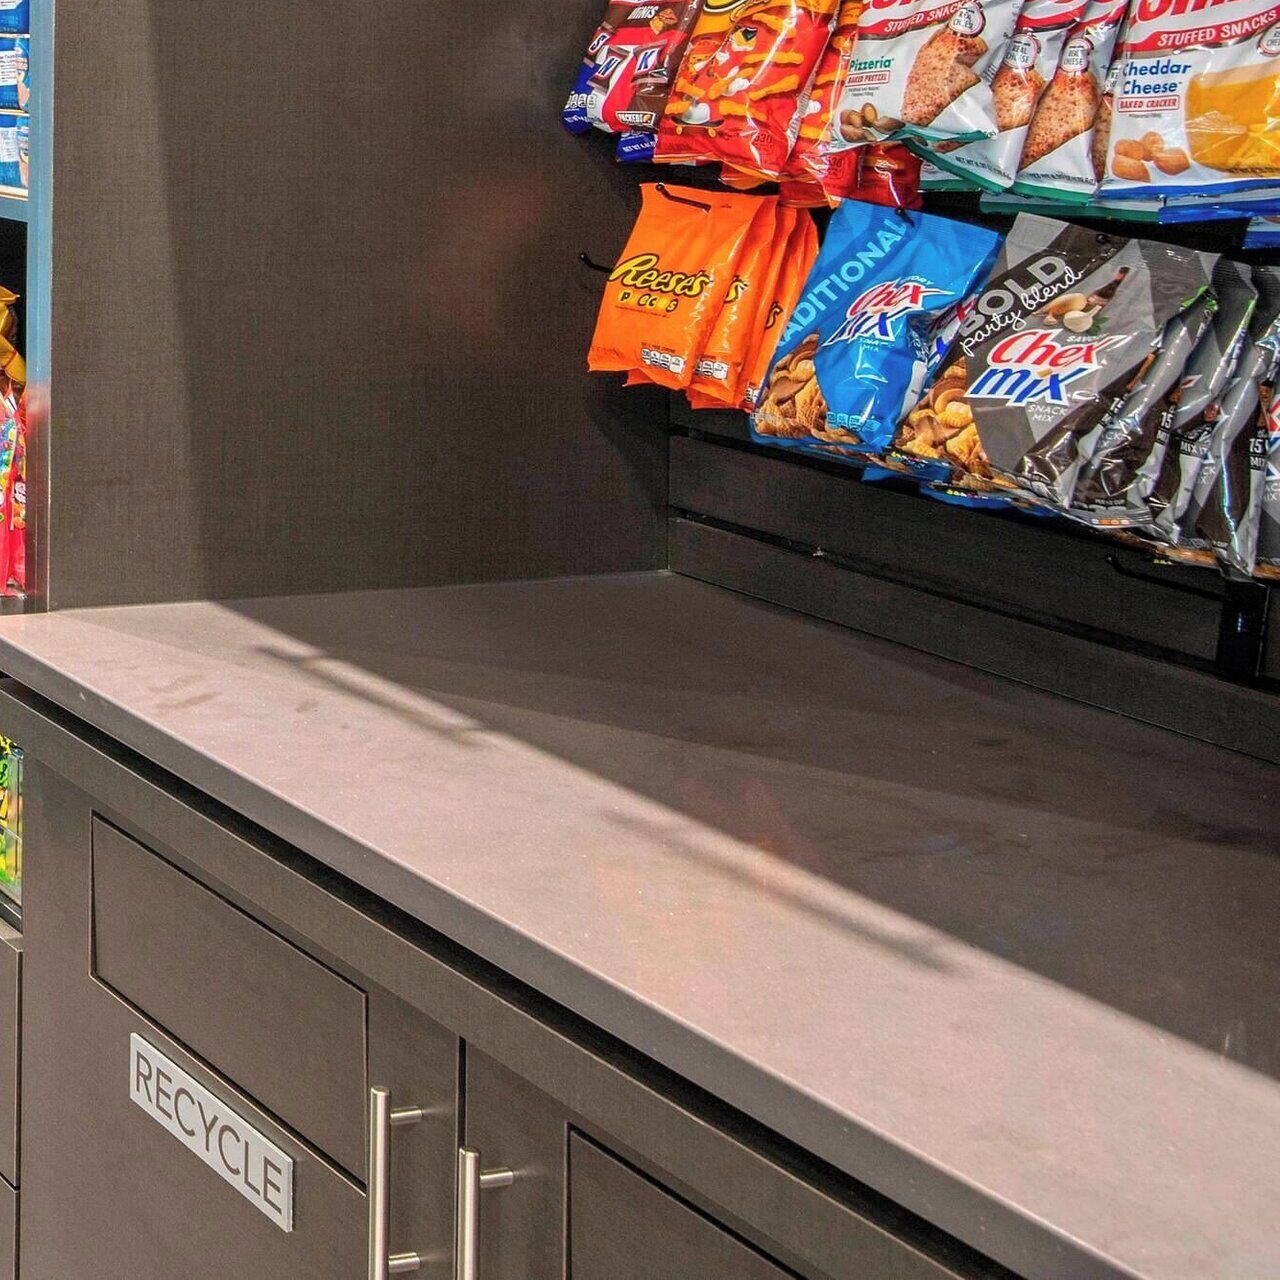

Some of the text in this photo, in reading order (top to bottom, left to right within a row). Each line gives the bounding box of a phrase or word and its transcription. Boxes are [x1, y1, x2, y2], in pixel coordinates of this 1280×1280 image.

[1157, 10, 1278, 48] STUFFED SNACKS
[849, 55, 892, 71] Pizzeria
[864, 72, 889, 83] PRETZEL
[1123, 59, 1193, 78] Cheddar
[1119, 97, 1178, 110] BAKED CRACKER
[1123, 80, 1179, 95] Cheese
[608, 253, 711, 298] Reese's
[778, 217, 908, 348] ADITIONAL
[960, 255, 1067, 338] BOLD
[960, 308, 1027, 358] party
[1020, 265, 1084, 311] blend
[989, 328, 1125, 369] Chex
[968, 367, 1085, 405] mix
[1028, 404, 1069, 416] SNACK
[1032, 413, 1054, 423] MIX
[136, 1050, 282, 1216] RECYCLE
